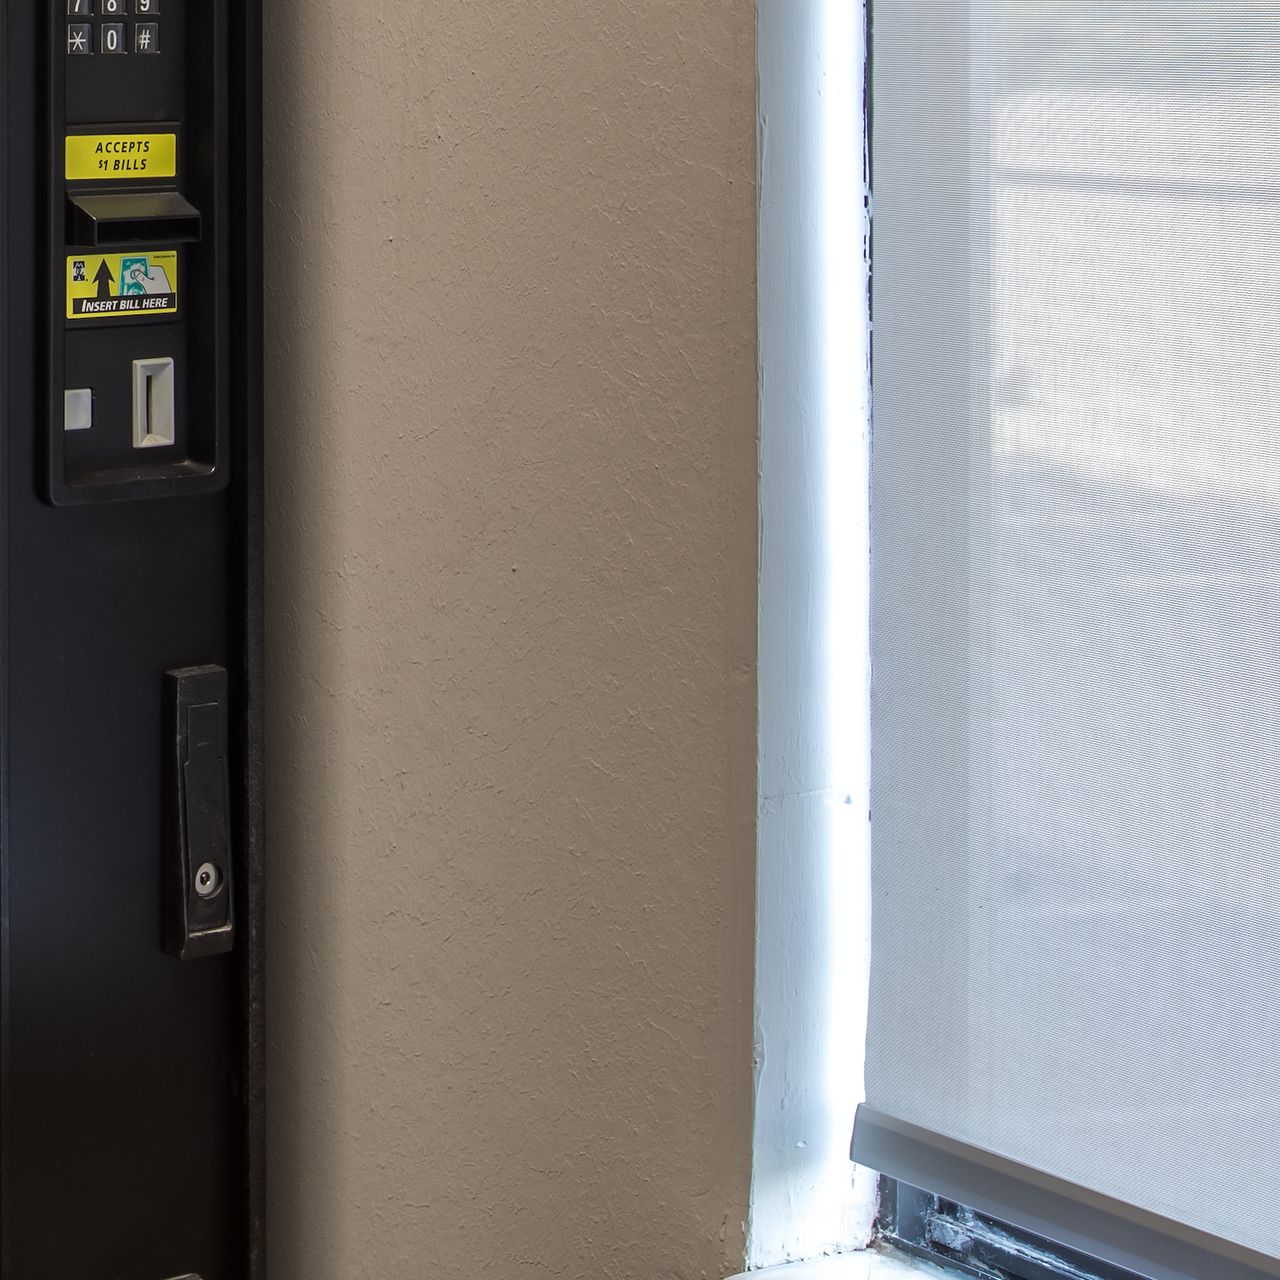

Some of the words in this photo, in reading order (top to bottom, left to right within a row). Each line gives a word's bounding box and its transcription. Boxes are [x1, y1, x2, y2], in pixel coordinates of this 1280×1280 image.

[95, 141, 150, 154] ACCEPTS
[98, 159, 109, 170] $1
[113, 158, 147, 170] BILLS
[82, 299, 118, 312] INSERT
[120, 298, 140, 310] BILL
[142, 297, 168, 309] HERE
